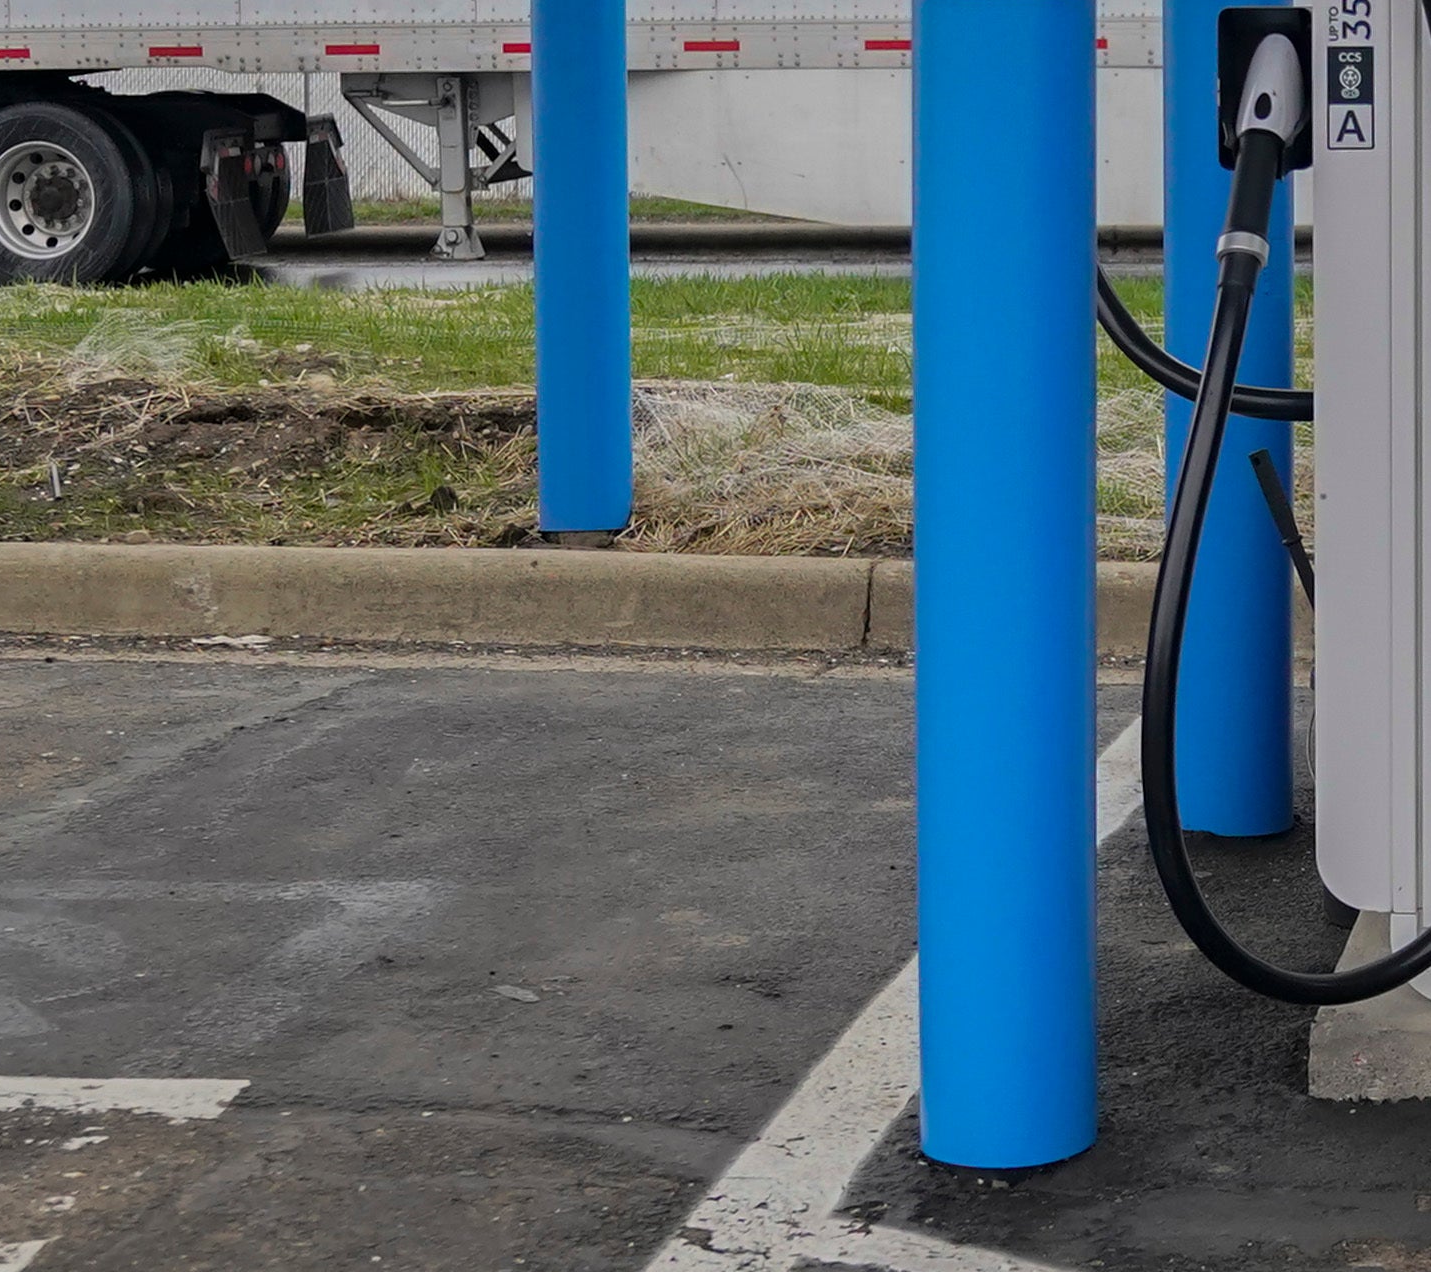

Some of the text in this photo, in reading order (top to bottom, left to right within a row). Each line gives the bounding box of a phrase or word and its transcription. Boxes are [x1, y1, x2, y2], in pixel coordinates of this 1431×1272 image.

[1329, 7, 1339, 42] UP TO
[1338, 52, 1363, 62] CCS
[1336, 110, 1366, 142] A
